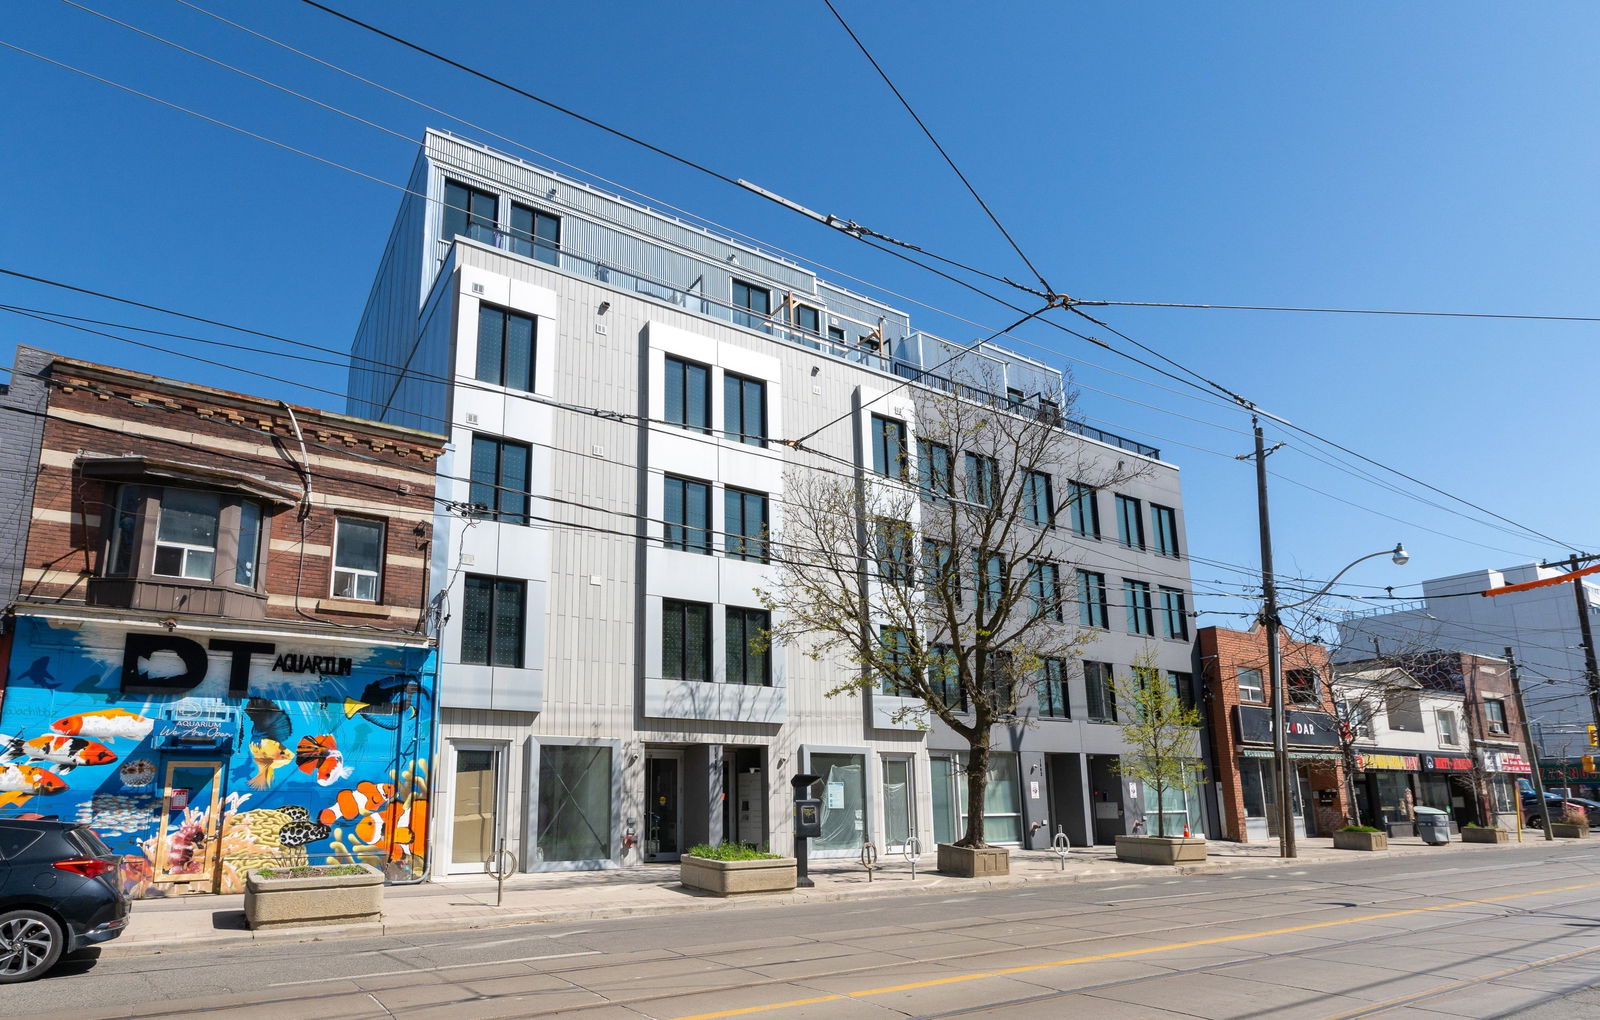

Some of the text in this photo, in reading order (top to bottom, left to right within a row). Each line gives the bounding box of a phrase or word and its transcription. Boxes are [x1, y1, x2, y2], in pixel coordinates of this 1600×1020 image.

[120, 632, 276, 698] DT
[272, 653, 353, 677] AQUARIUM
[160, 725, 233, 739] We Are Open
[176, 720, 221, 728] AQUARIUM
